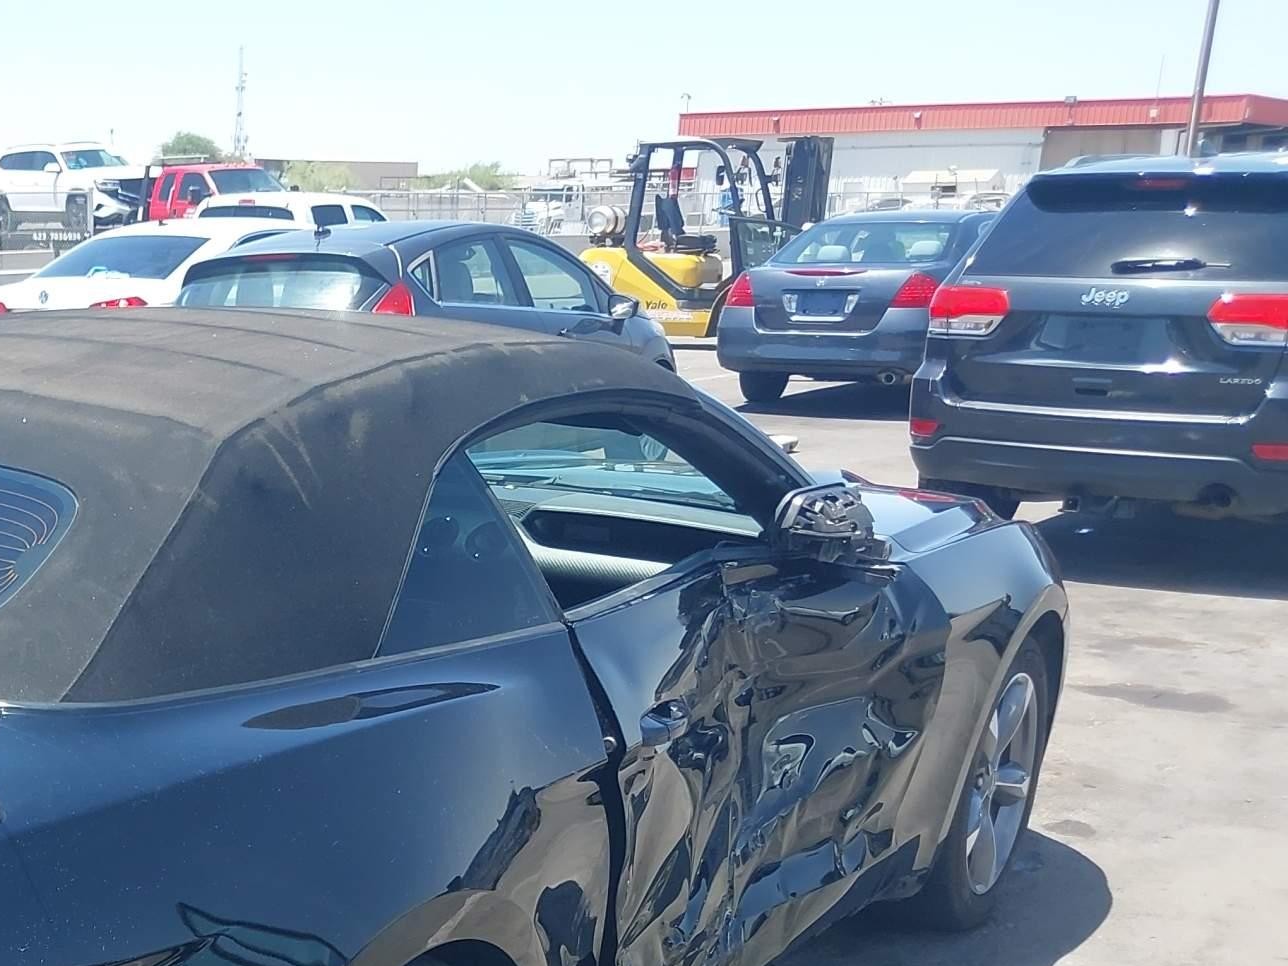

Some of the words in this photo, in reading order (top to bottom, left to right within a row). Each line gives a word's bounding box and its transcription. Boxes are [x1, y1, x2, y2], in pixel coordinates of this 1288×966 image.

[1081, 287, 1129, 307] Jeep
[645, 300, 668, 310] Yale
[1219, 377, 1262, 385] LAREDO
